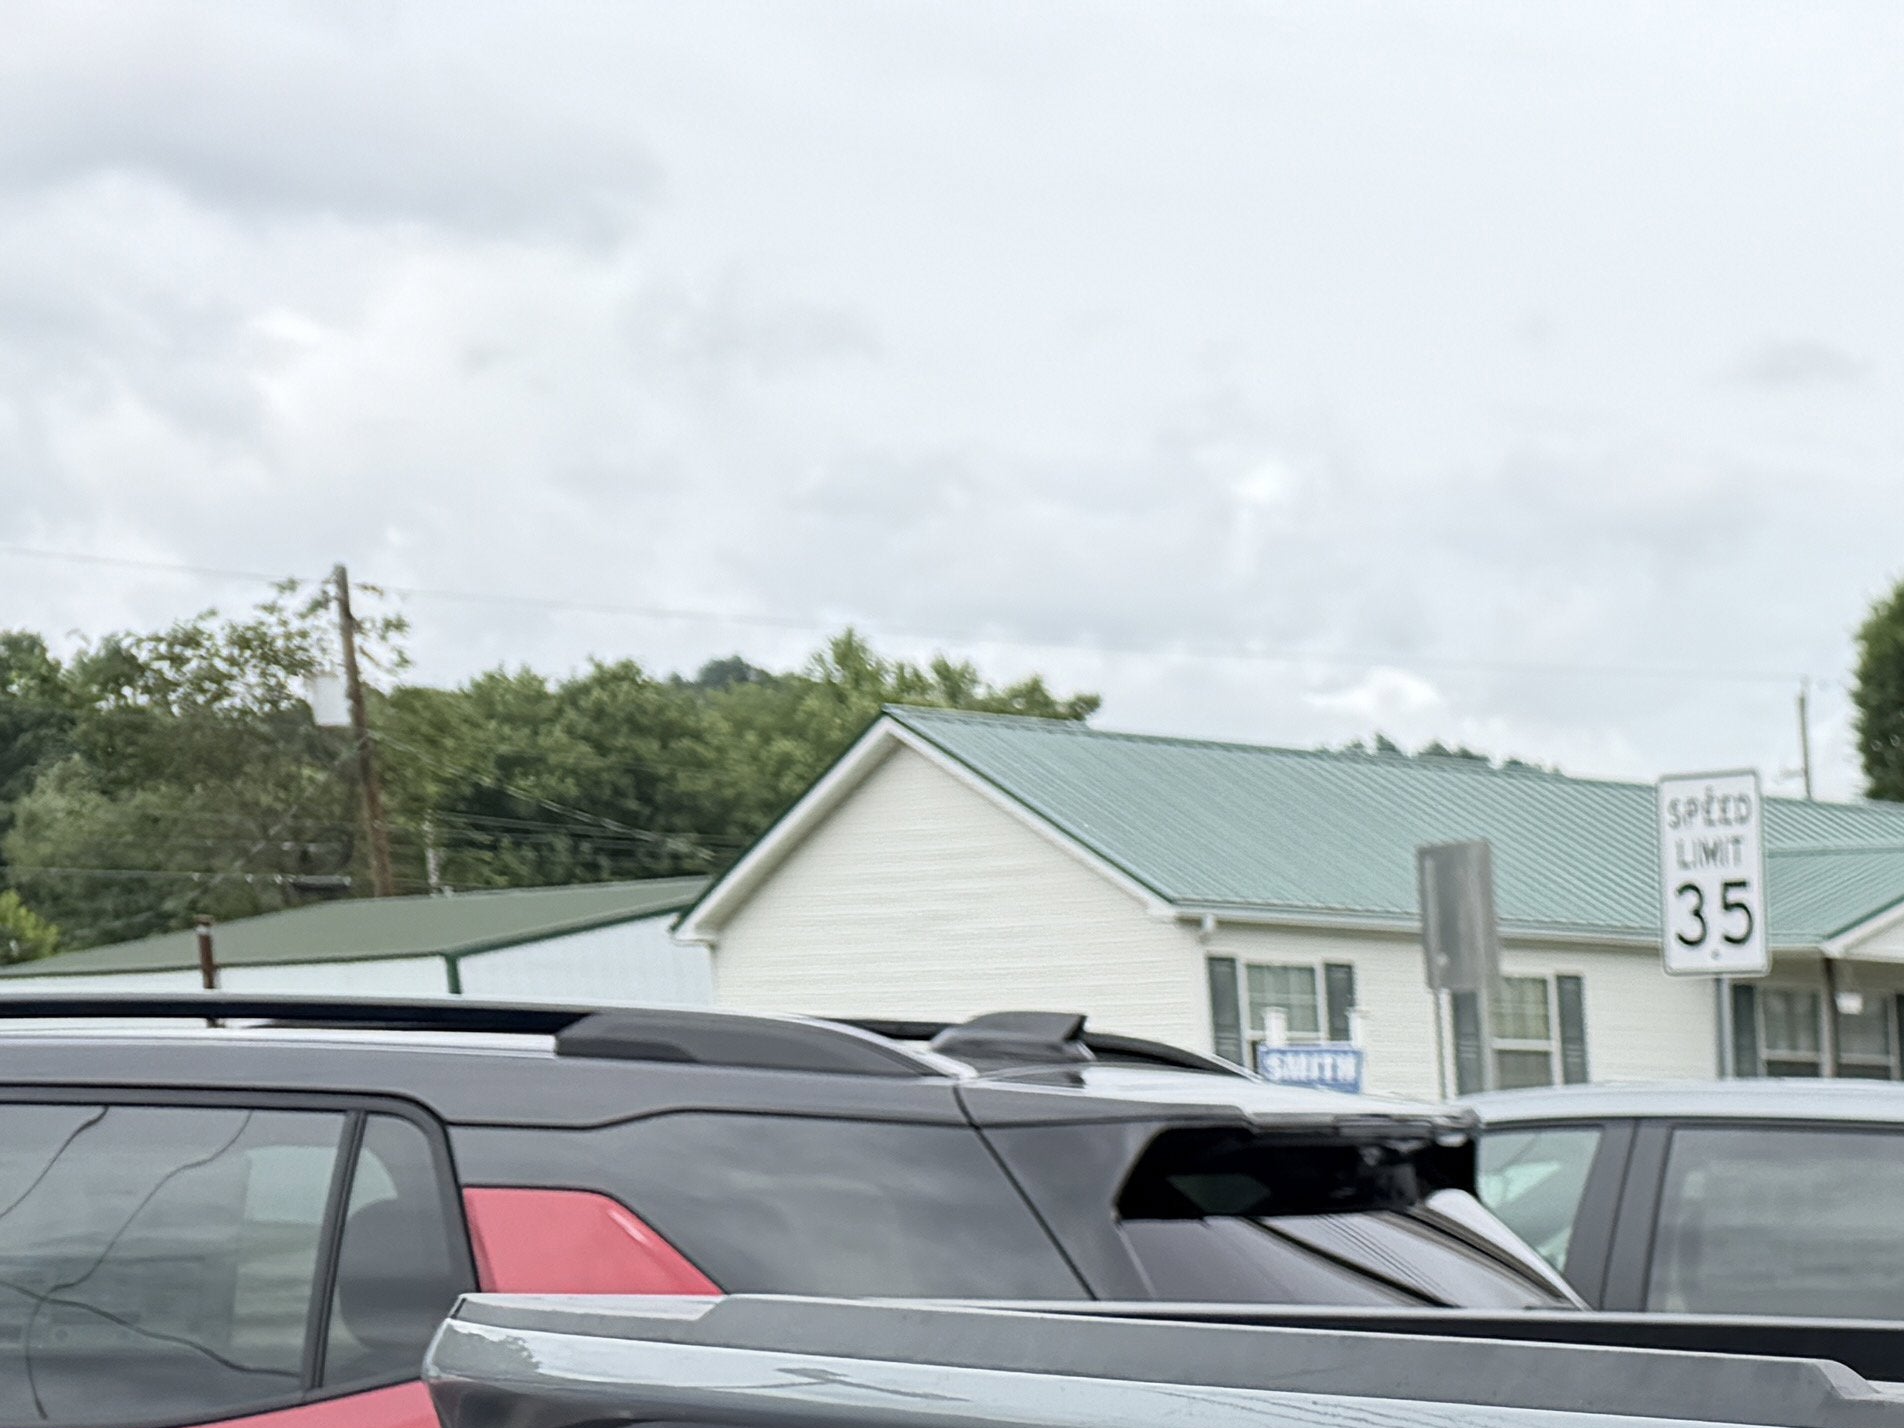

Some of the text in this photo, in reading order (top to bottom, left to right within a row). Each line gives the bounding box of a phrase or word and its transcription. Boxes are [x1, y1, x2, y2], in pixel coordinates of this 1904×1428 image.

[1667, 788, 1751, 830] SPEED
[1676, 835, 1745, 869] LIMIT
[1674, 880, 1754, 947] 35
